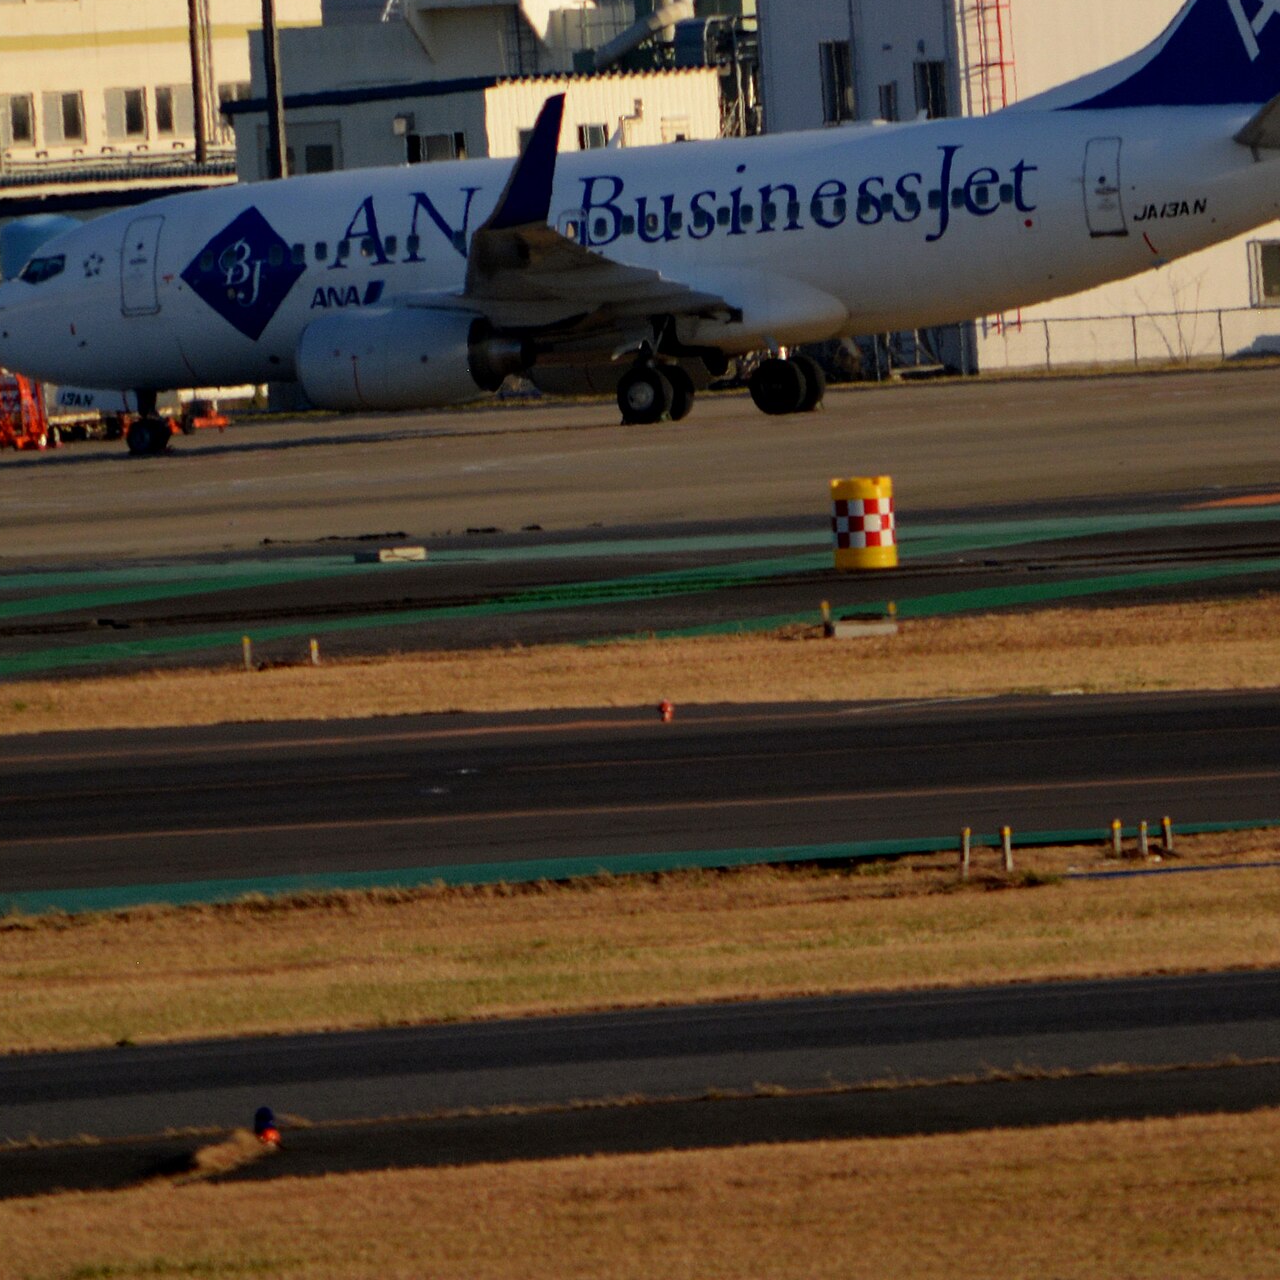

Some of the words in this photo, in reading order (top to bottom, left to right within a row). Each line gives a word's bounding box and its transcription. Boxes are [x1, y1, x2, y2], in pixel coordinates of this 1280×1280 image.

[327, 186, 483, 269] AN
[579, 144, 1039, 247] BusinessJet
[1133, 197, 1207, 221] JA13AN
[310, 286, 361, 308] ANA
